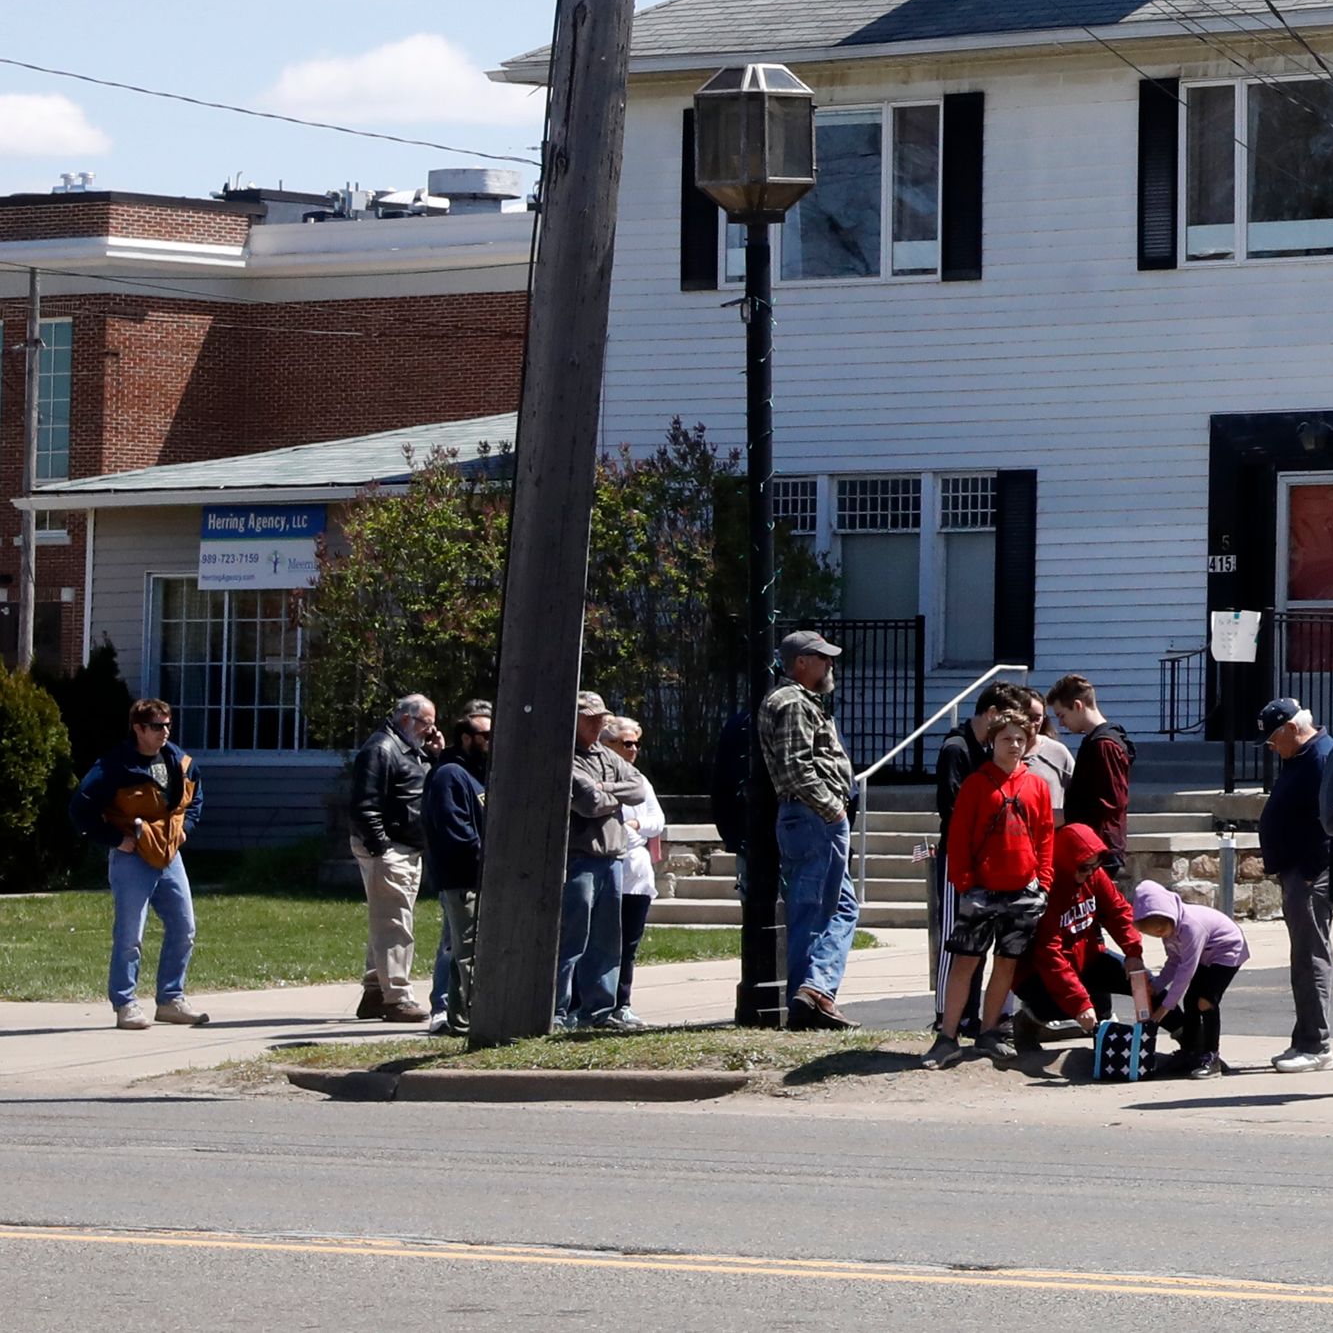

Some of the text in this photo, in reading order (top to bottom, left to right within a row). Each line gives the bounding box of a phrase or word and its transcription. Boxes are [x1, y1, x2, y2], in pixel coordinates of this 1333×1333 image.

[208, 513, 308, 533] Herring Agency, LLC
